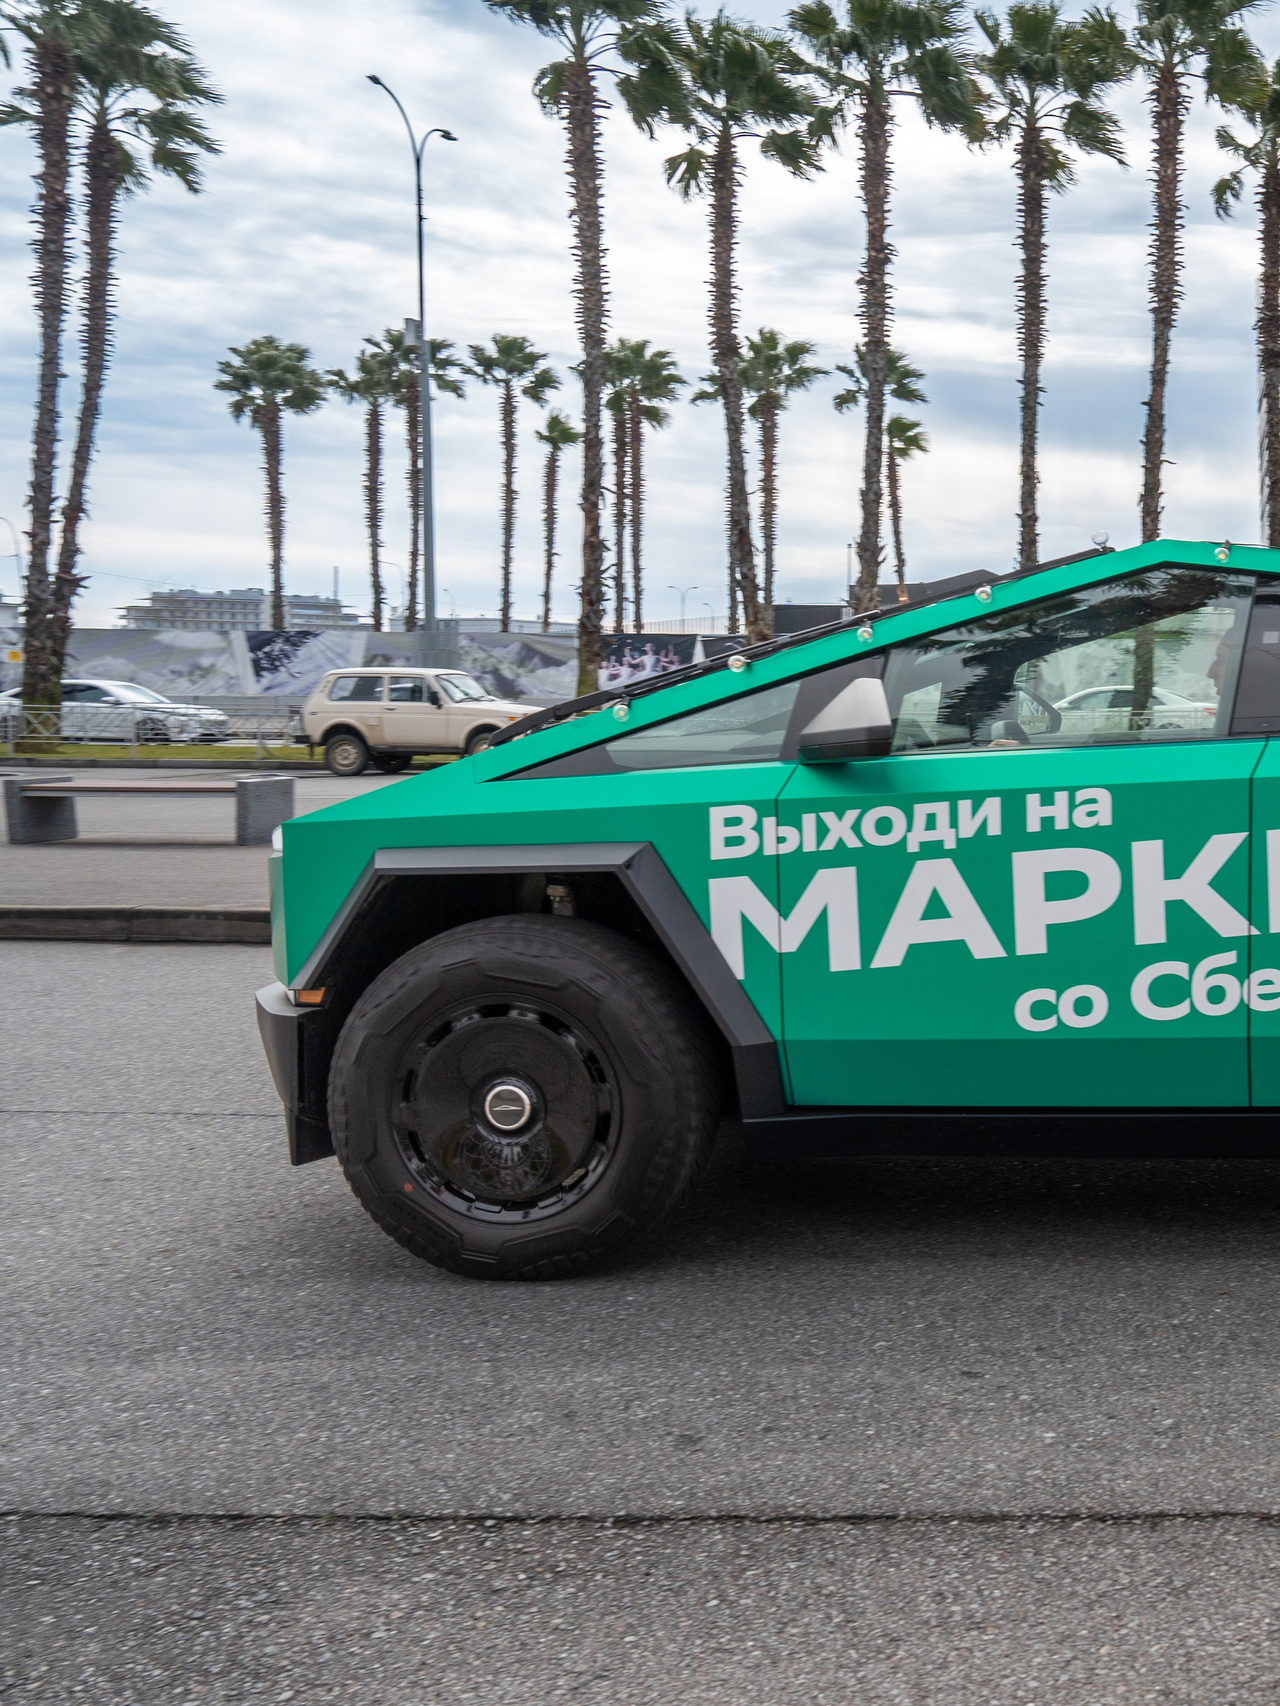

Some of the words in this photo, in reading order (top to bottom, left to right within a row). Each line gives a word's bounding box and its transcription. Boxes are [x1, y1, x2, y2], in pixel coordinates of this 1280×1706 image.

[709, 796, 1002, 861] Выходи
[1025, 787, 1113, 833] на
[1013, 984, 1109, 1032] со
